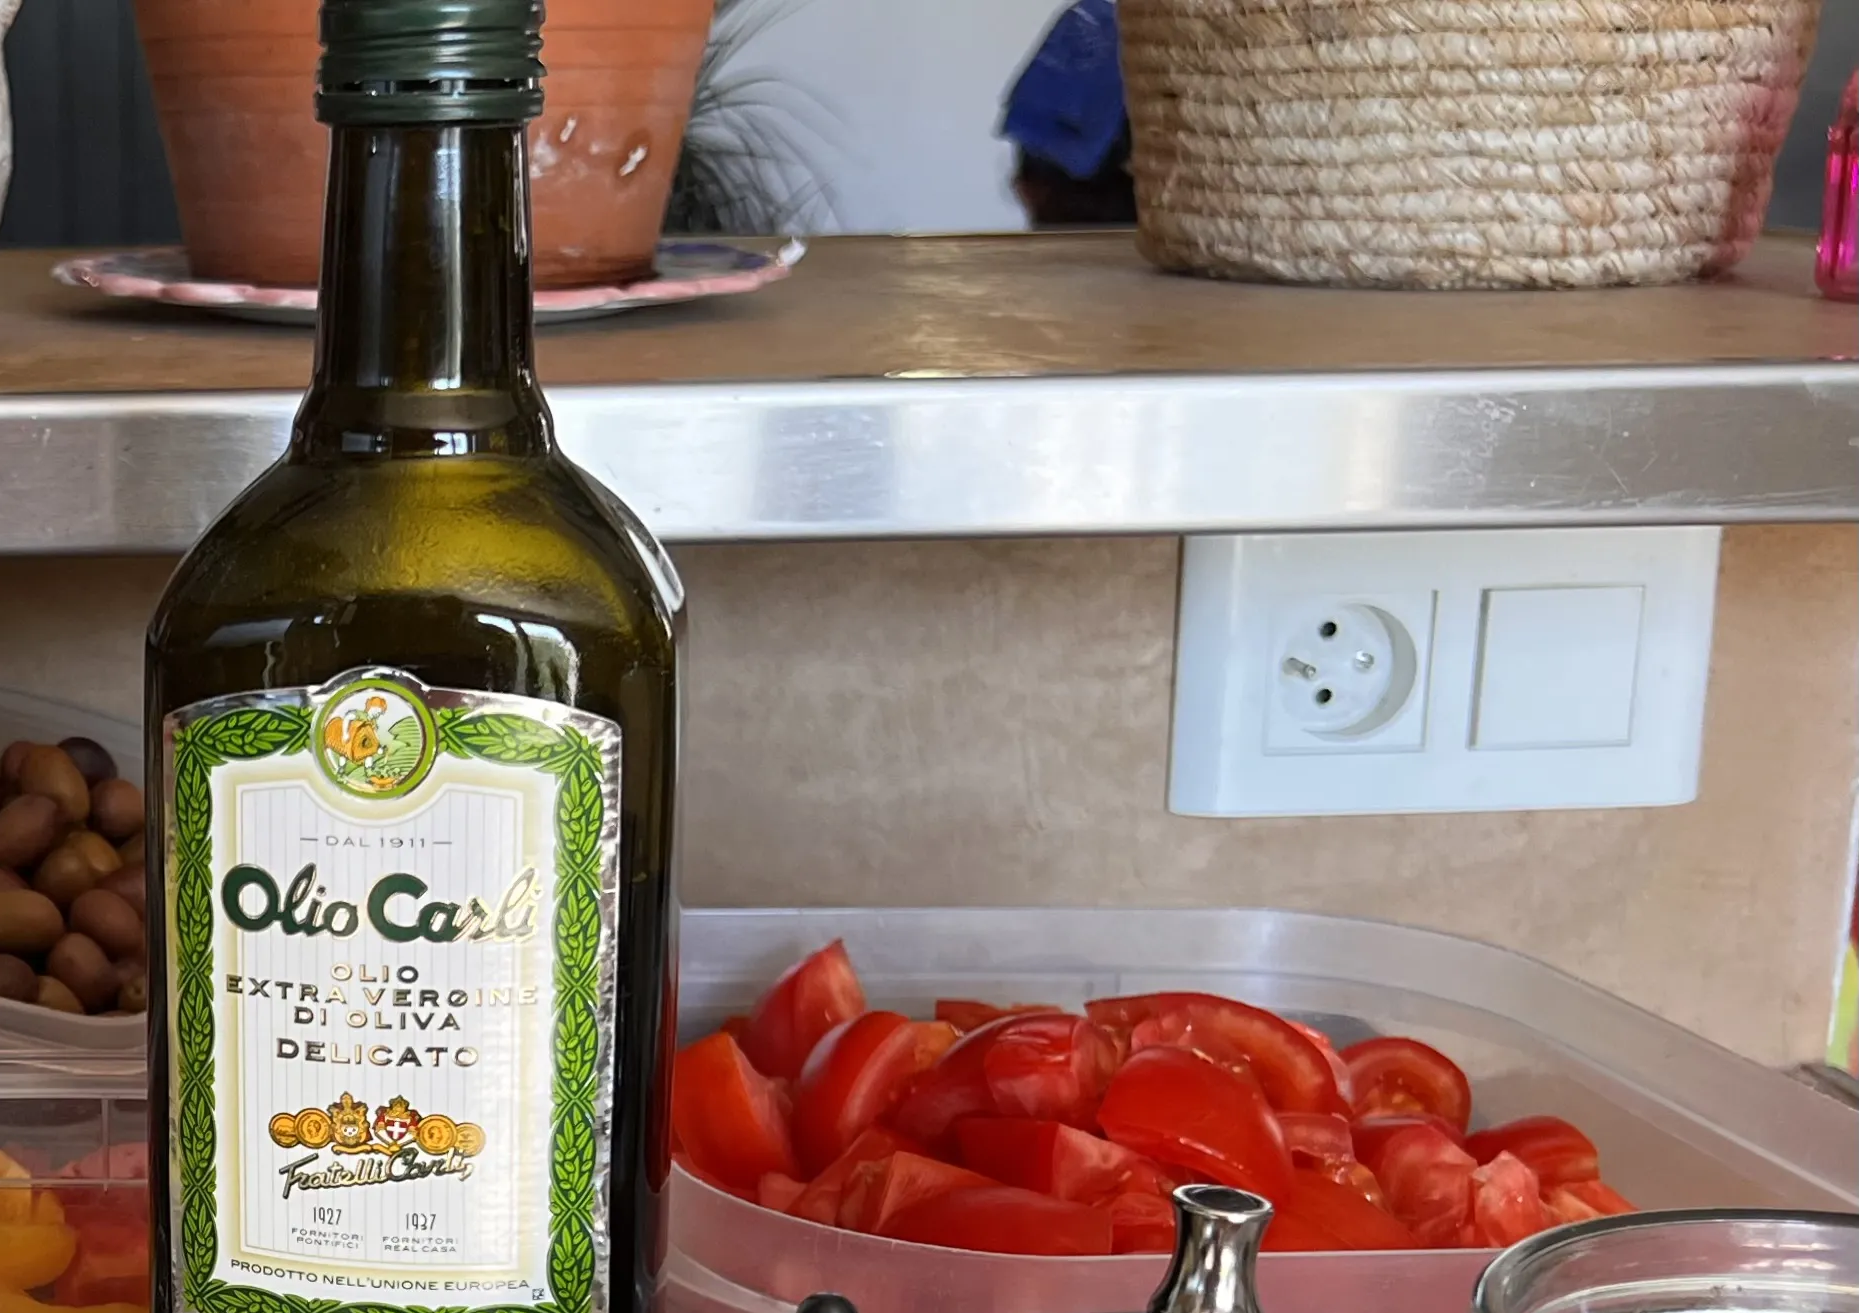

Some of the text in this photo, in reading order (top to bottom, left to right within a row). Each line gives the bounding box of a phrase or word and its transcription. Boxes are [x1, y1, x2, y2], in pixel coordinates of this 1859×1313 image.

[326, 836, 427, 850] DAL 1911
[221, 862, 545, 943] Olio Carli
[330, 963, 419, 983] OLIO
[225, 974, 347, 1005] EXTRA
[293, 1006, 461, 1031] DI OLIVA
[276, 1038, 479, 1067] DELICATO
[312, 1206, 343, 1227] 1927
[230, 1259, 531, 1292] PRODOTTO NELL'UNIONE EUROPEA
